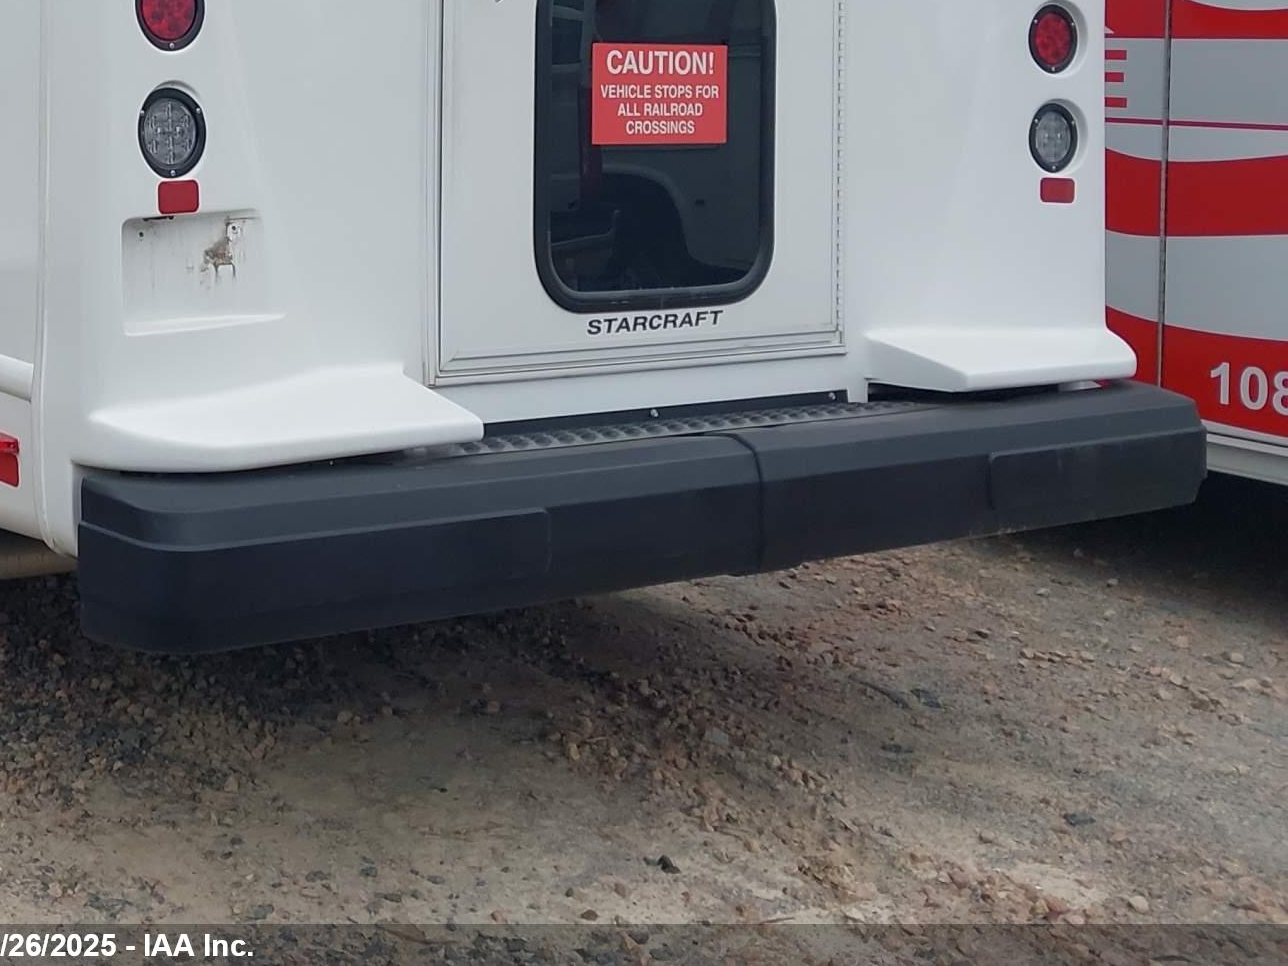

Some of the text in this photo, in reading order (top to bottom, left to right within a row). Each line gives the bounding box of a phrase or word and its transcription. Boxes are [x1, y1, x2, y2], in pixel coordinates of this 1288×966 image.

[606, 50, 714, 75] CAUTION!
[600, 84, 720, 99] VEHICLE STOPS FOR
[617, 103, 703, 116] ALL RAILROAD
[626, 121, 695, 134] CROSSINGS
[587, 310, 724, 335] STARCRAFT
